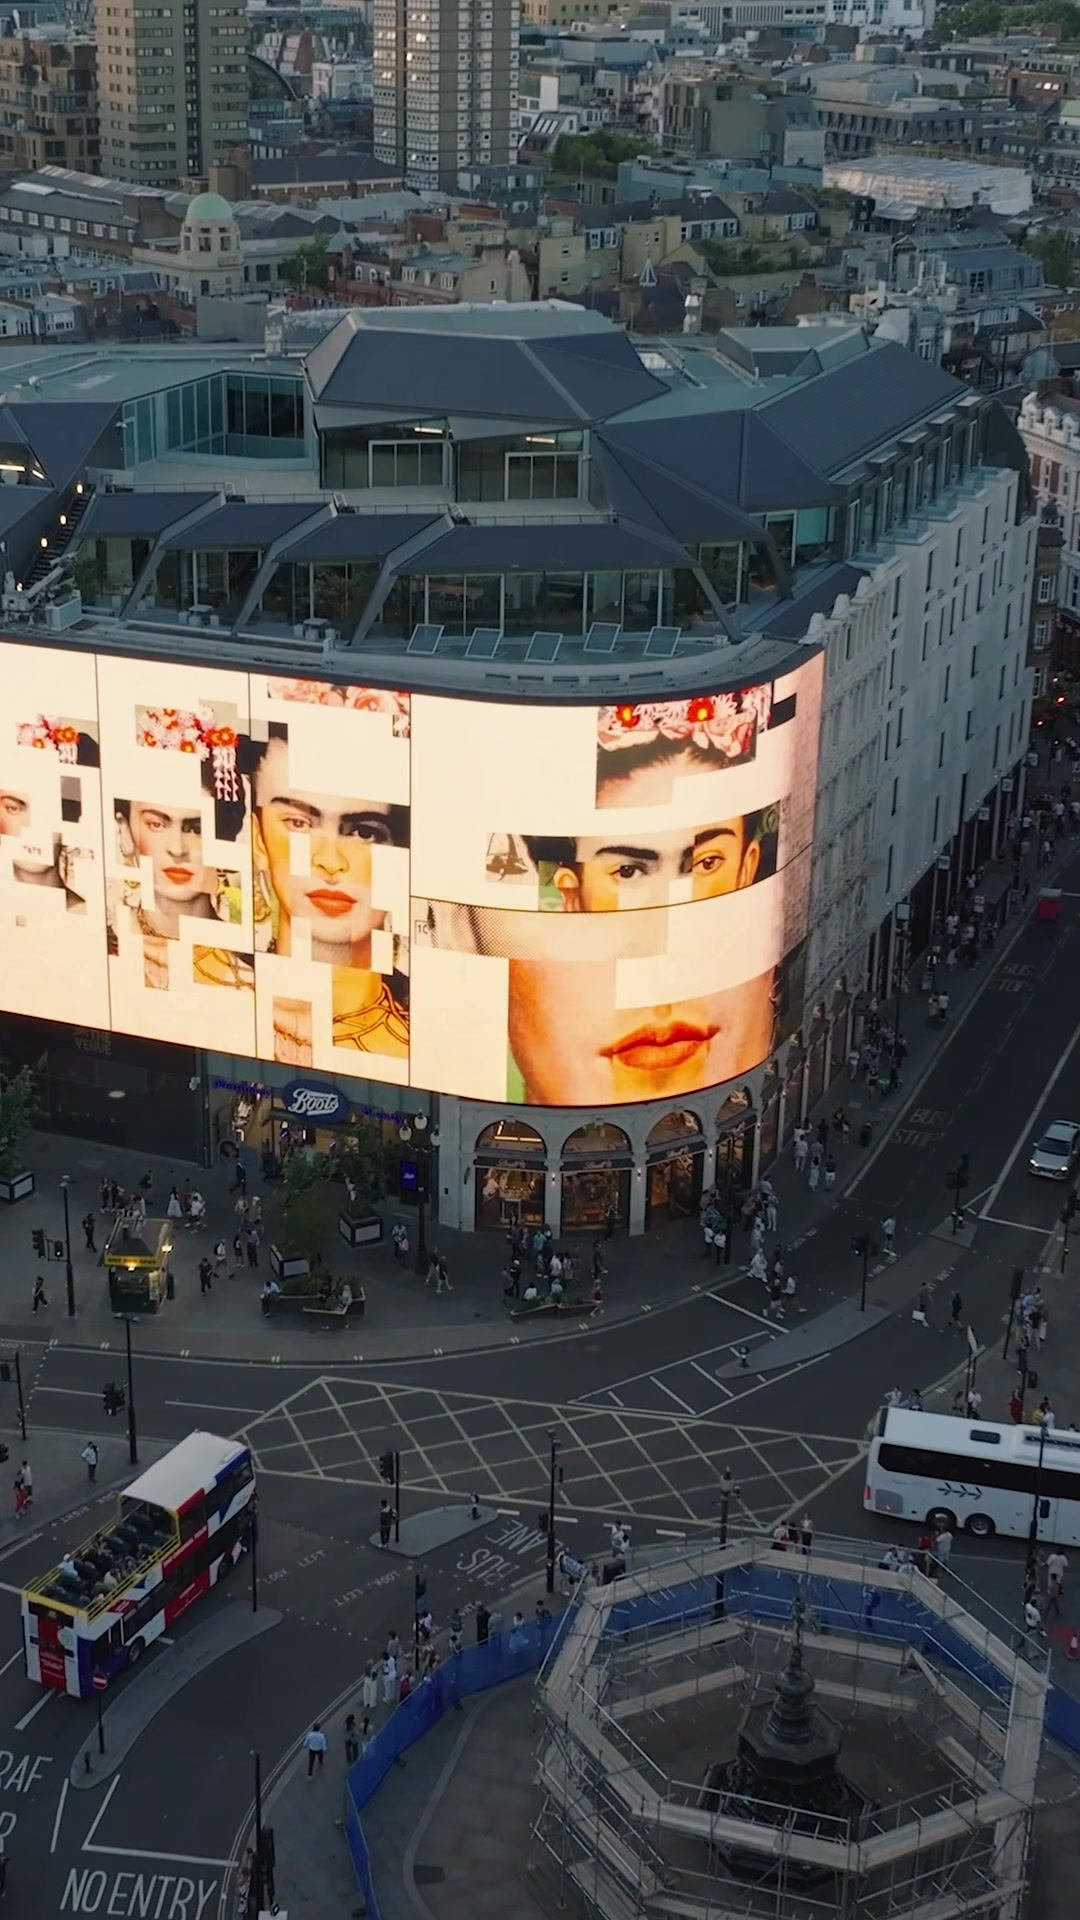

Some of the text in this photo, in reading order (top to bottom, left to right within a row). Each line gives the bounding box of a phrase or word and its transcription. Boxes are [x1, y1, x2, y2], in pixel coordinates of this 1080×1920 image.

[287, 1087, 340, 1117] Boots
[909, 1108, 948, 1126] BUS
[890, 1128, 944, 1148] STOP
[296, 1549, 327, 1568] LEFT
[456, 1548, 520, 1586] BUS
[333, 1587, 364, 1608] LEFT
[59, 1868, 218, 1920] NO ENTRY
